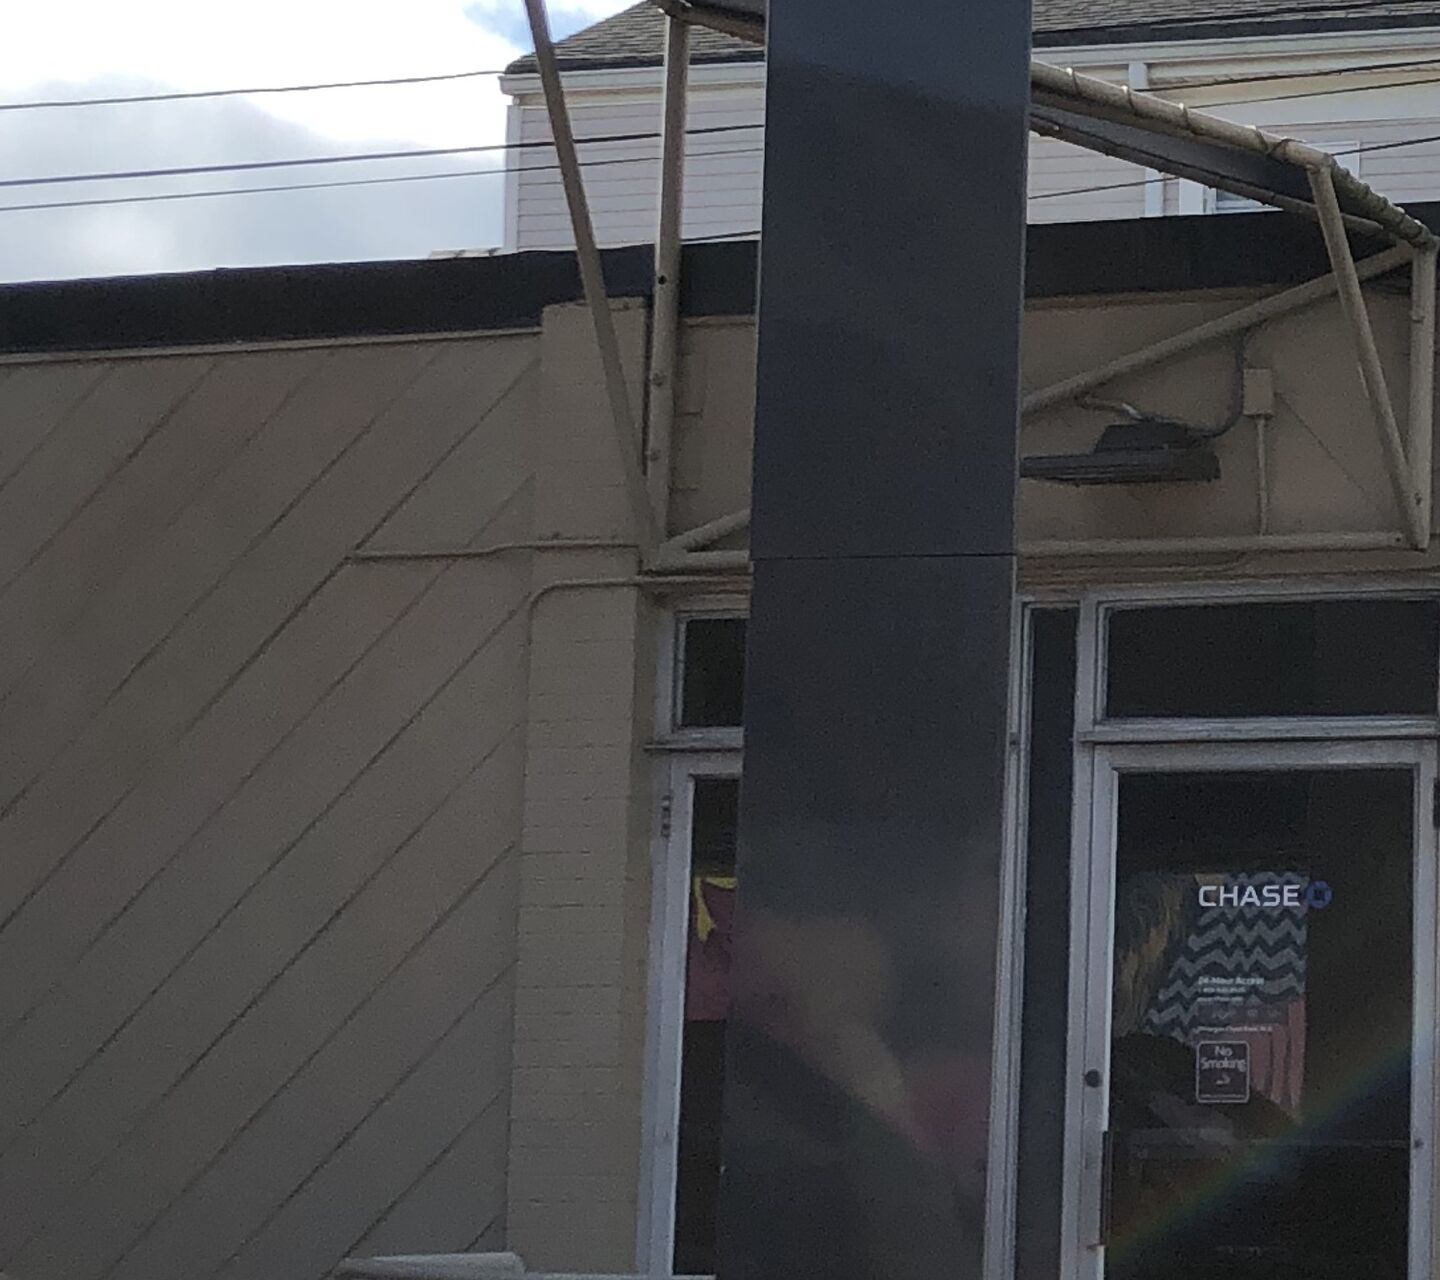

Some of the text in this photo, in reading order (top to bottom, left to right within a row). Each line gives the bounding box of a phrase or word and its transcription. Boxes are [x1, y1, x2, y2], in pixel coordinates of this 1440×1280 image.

[1198, 884, 1301, 907] CHASE
[1214, 1045, 1233, 1058] No
[1200, 1057, 1247, 1073] Smoking
